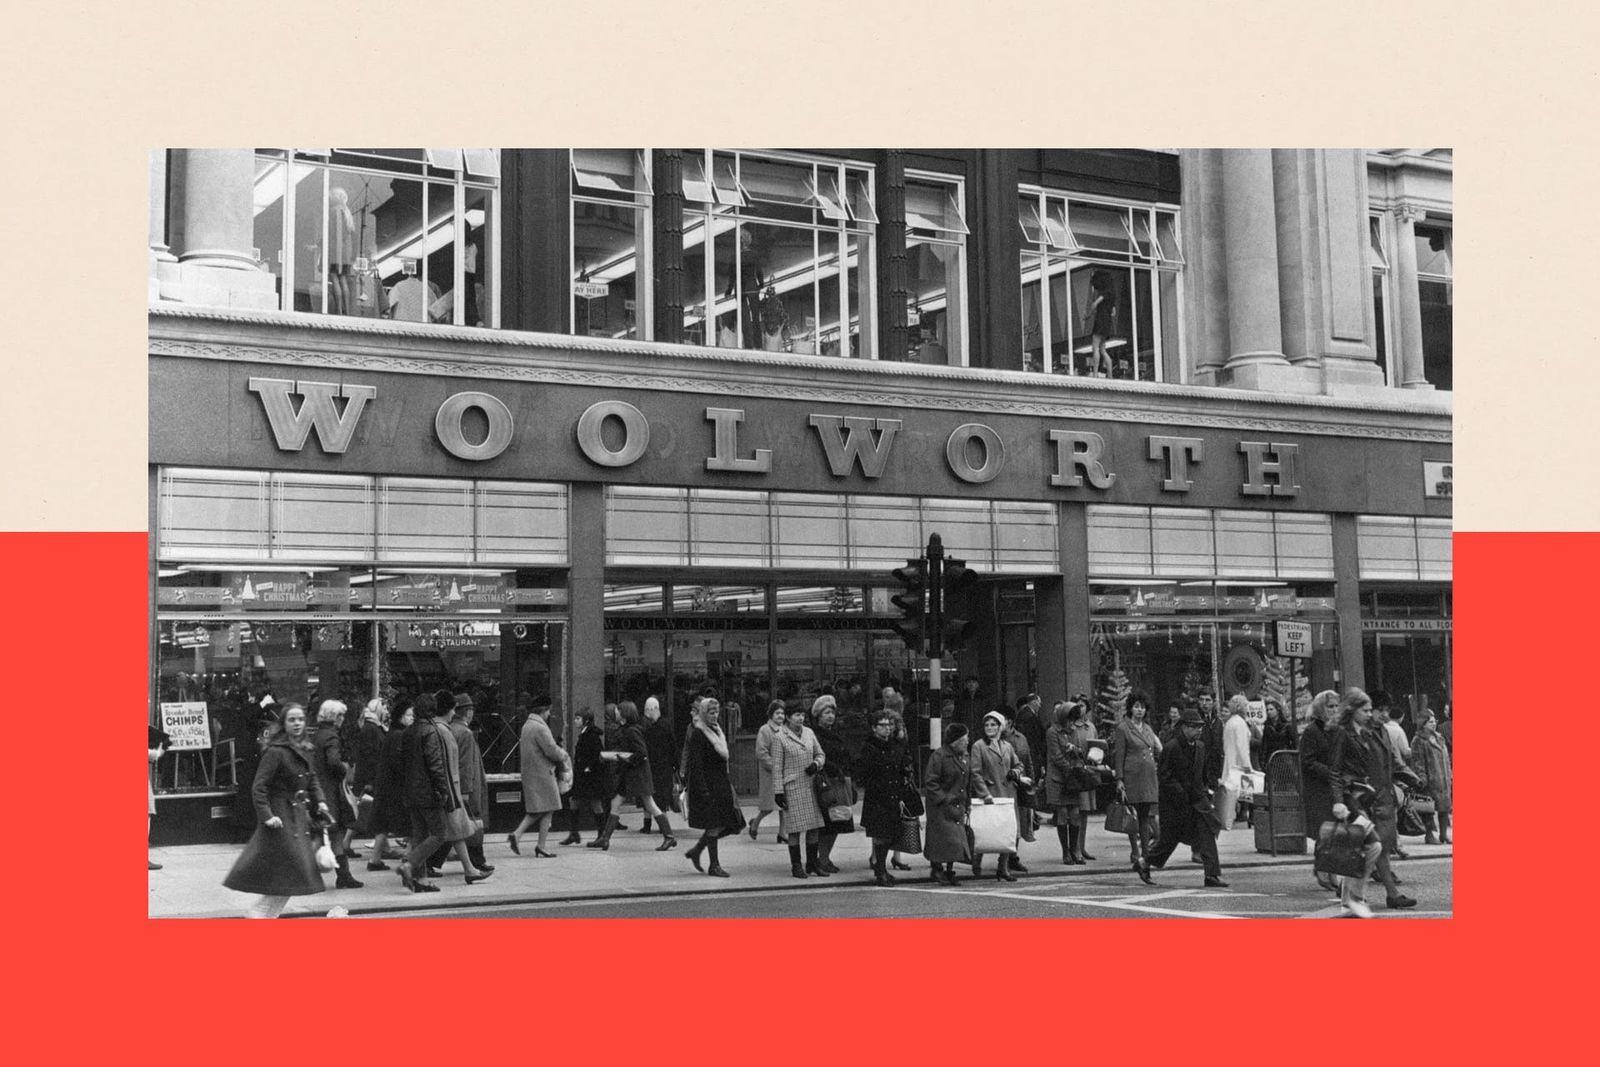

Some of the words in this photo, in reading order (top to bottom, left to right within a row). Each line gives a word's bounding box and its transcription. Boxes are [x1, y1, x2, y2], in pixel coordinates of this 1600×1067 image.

[248, 376, 1301, 497] WOOLWORTH
[264, 592, 305, 602] CHRISTMAS
[1404, 621, 1415, 629] TO
[1420, 621, 1433, 629] ALL
[1287, 631, 1303, 640] KEEP
[421, 639, 426, 647] &
[1285, 641, 1306, 653] LEFT
[165, 715, 204, 727] CHIMPS
